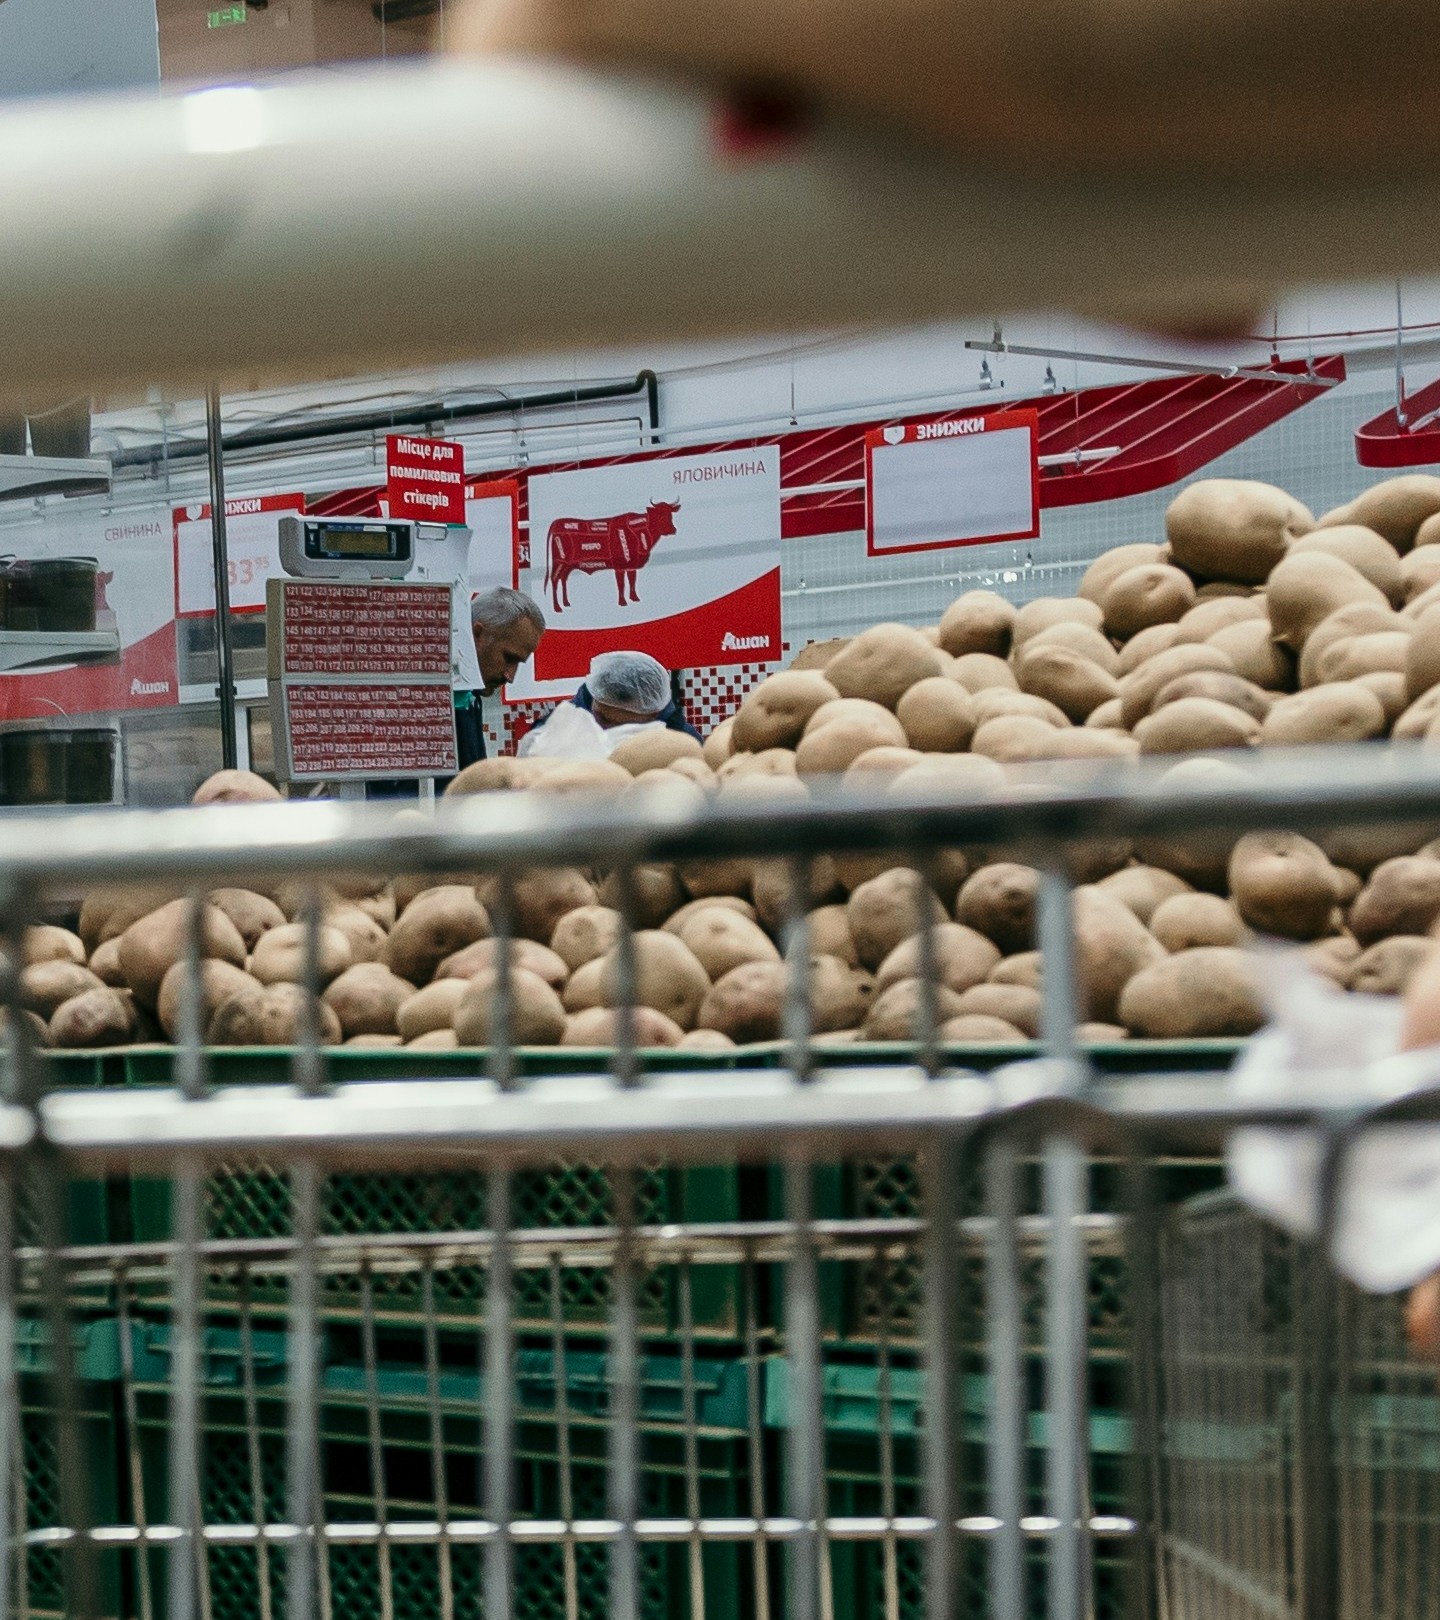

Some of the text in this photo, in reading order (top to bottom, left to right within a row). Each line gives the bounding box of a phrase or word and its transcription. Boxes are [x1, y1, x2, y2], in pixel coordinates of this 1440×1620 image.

[916, 414, 986, 442] ЗНИЖКИ
[397, 438, 454, 460] Місце для
[390, 464, 461, 485] помилкових
[672, 460, 767, 485] ЯЛОВИЧИНА
[404, 490, 449, 510] стікерів
[104, 521, 163, 542] СВИНИНА
[720, 631, 770, 652] Ашан
[129, 677, 170, 695] Ашан
